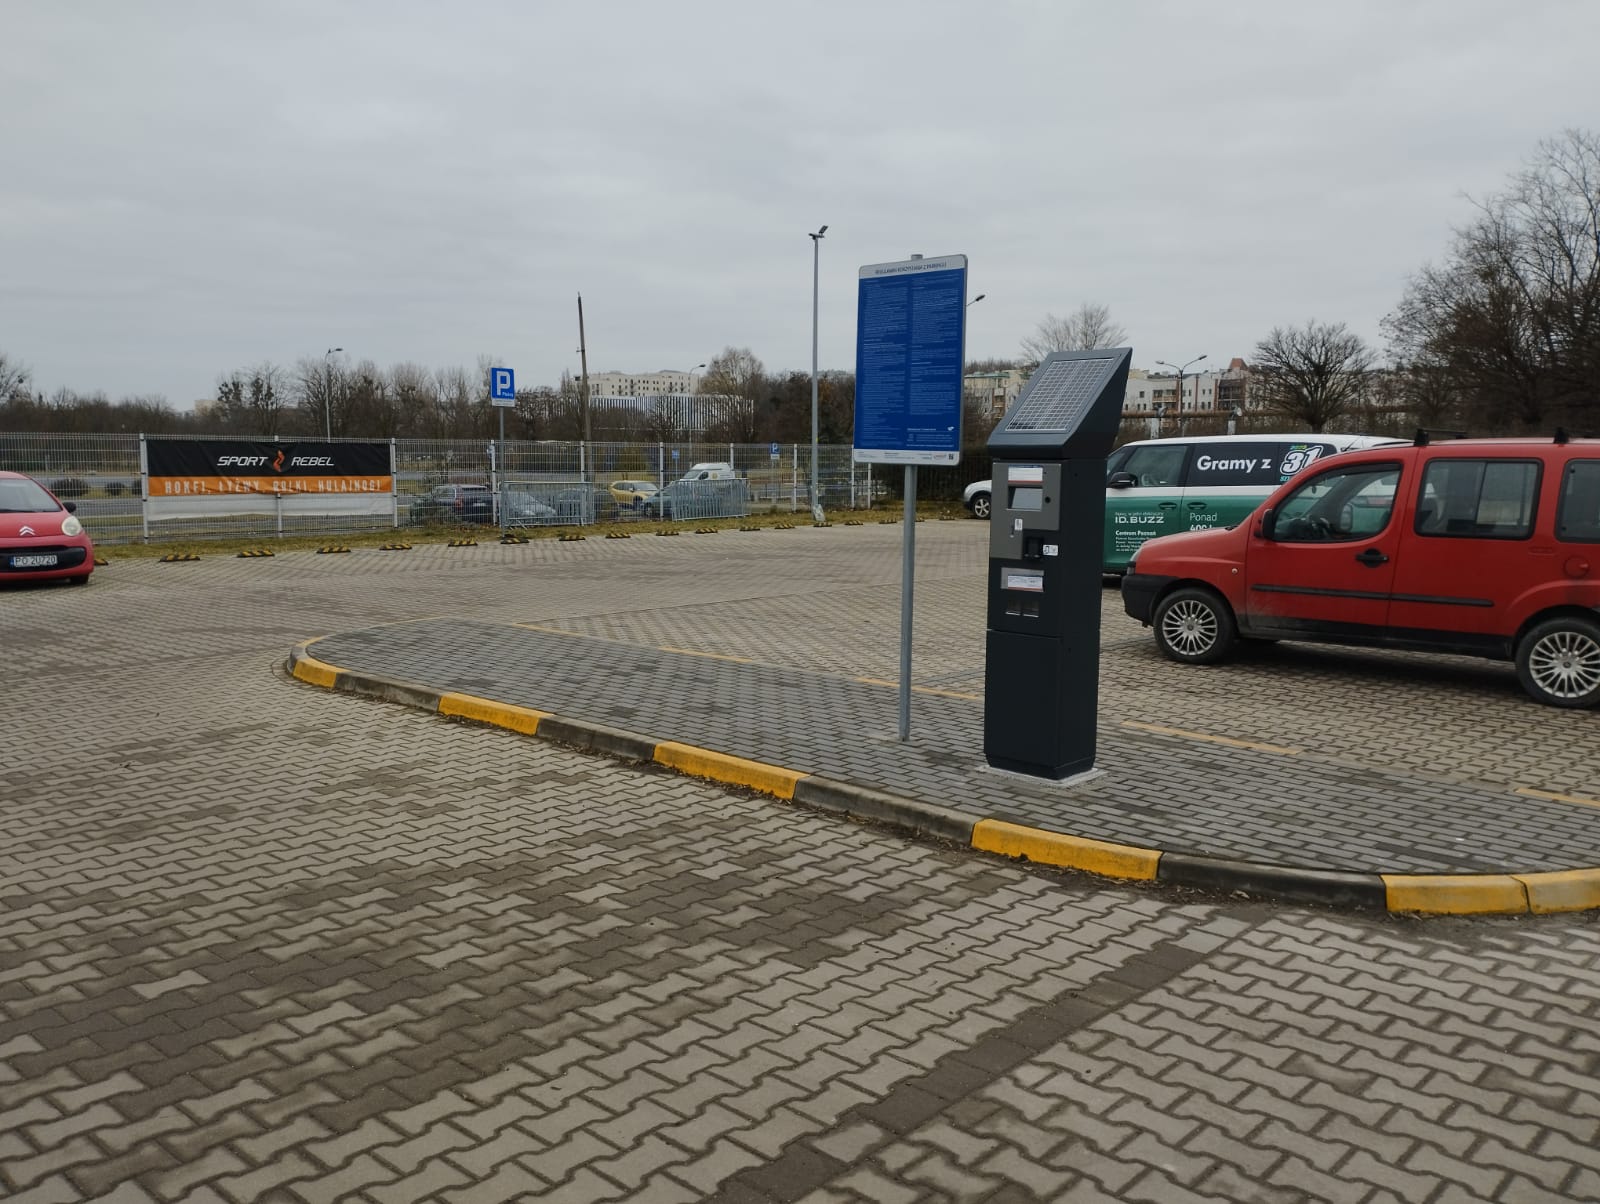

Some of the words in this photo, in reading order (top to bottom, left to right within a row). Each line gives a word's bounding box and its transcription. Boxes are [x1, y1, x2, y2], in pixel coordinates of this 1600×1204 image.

[496, 371, 511, 395] P
[216, 455, 269, 467] SPORT
[291, 456, 335, 467] REBEL
[1197, 455, 1256, 473] Gramy
[1260, 457, 1271, 470] z
[1189, 512, 1218, 522] Ponad
[15, 557, 28, 565] PO
